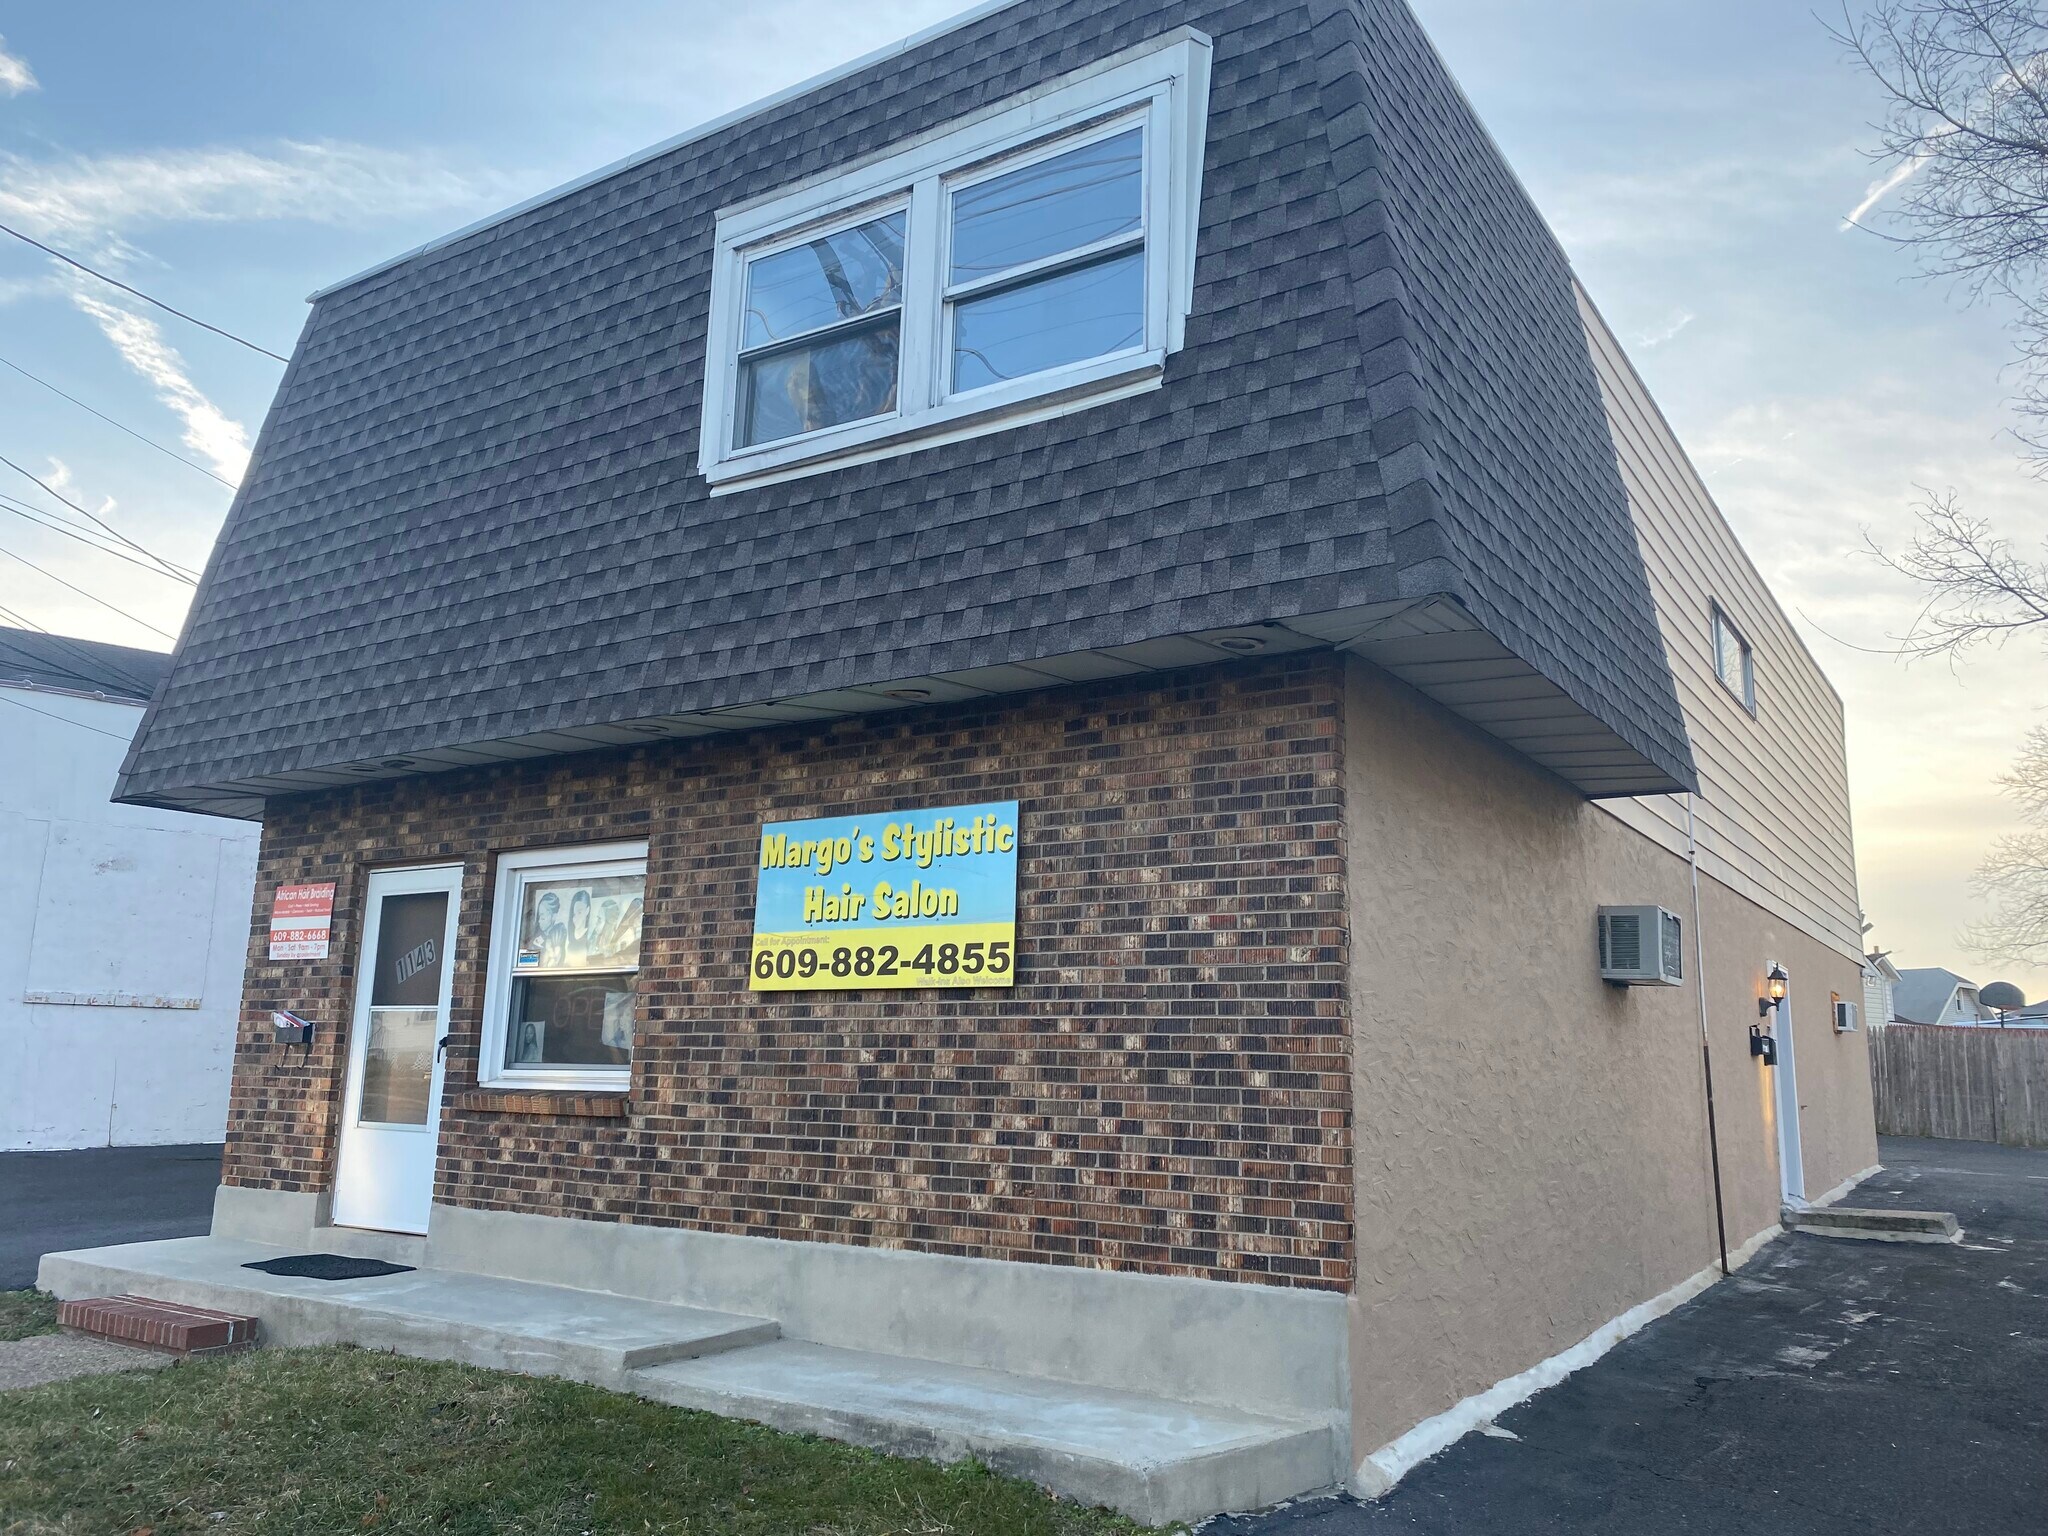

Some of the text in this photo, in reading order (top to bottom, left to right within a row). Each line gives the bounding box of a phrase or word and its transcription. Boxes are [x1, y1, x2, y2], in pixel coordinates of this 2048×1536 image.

[761, 813, 1015, 876] Margo's Stylistic
[276, 888, 334, 901] African Hair Braiding
[803, 879, 959, 924] Hair Salon
[273, 930, 326, 941] 609-882-6668
[755, 935, 830, 947] Call for Appointment:
[397, 941, 435, 981] 1143
[754, 941, 1011, 979] 609-882-4855
[951, 976, 970, 985] Also
[972, 976, 1012, 985] Welcome
[553, 996, 605, 1030] OPE
